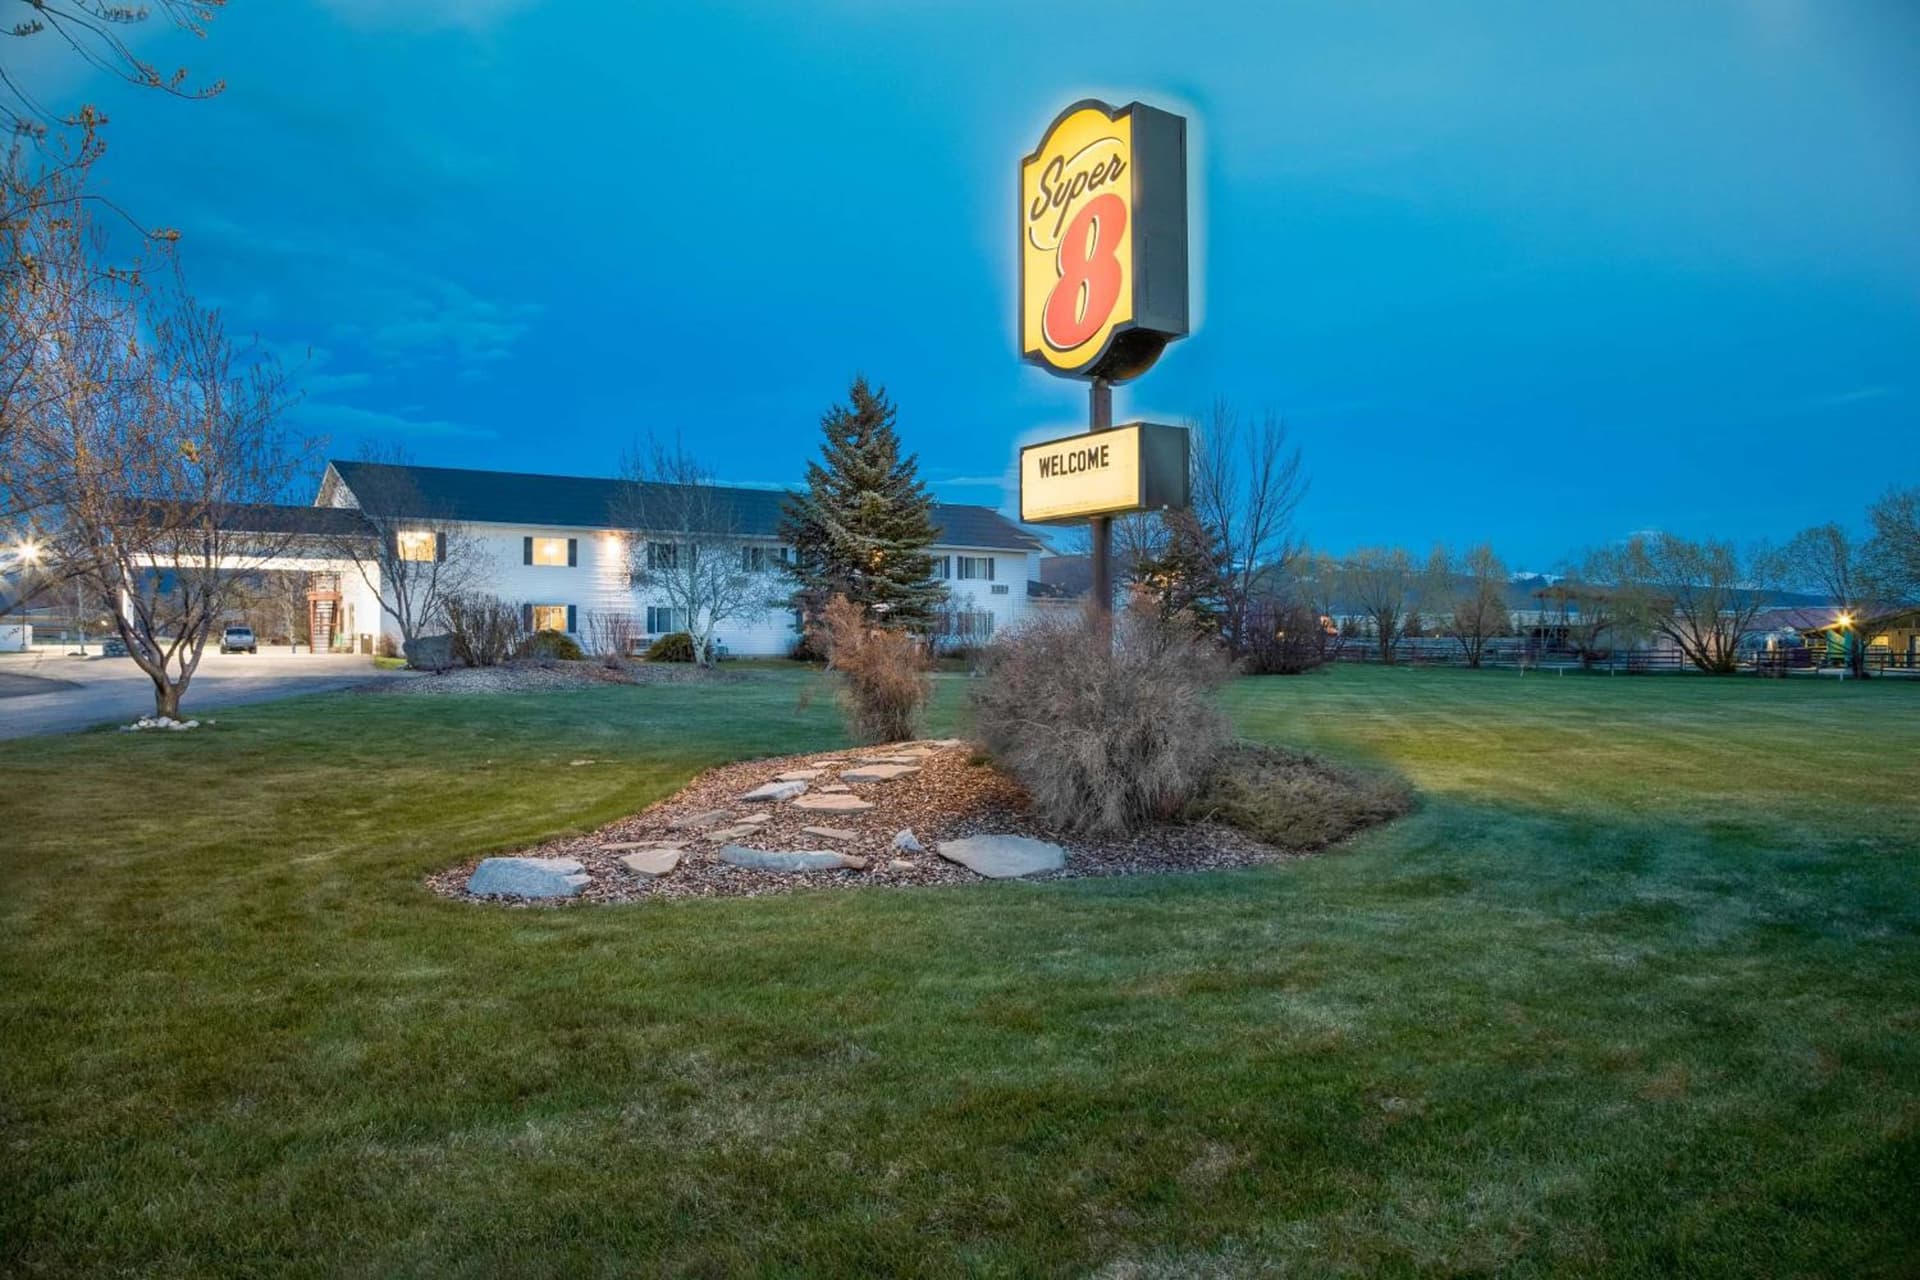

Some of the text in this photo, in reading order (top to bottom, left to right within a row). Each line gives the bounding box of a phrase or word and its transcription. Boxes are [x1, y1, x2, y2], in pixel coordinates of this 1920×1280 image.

[1030, 153, 1127, 239] Super
[1042, 193, 1127, 352] 8
[1039, 445, 1110, 478] WELCOME
